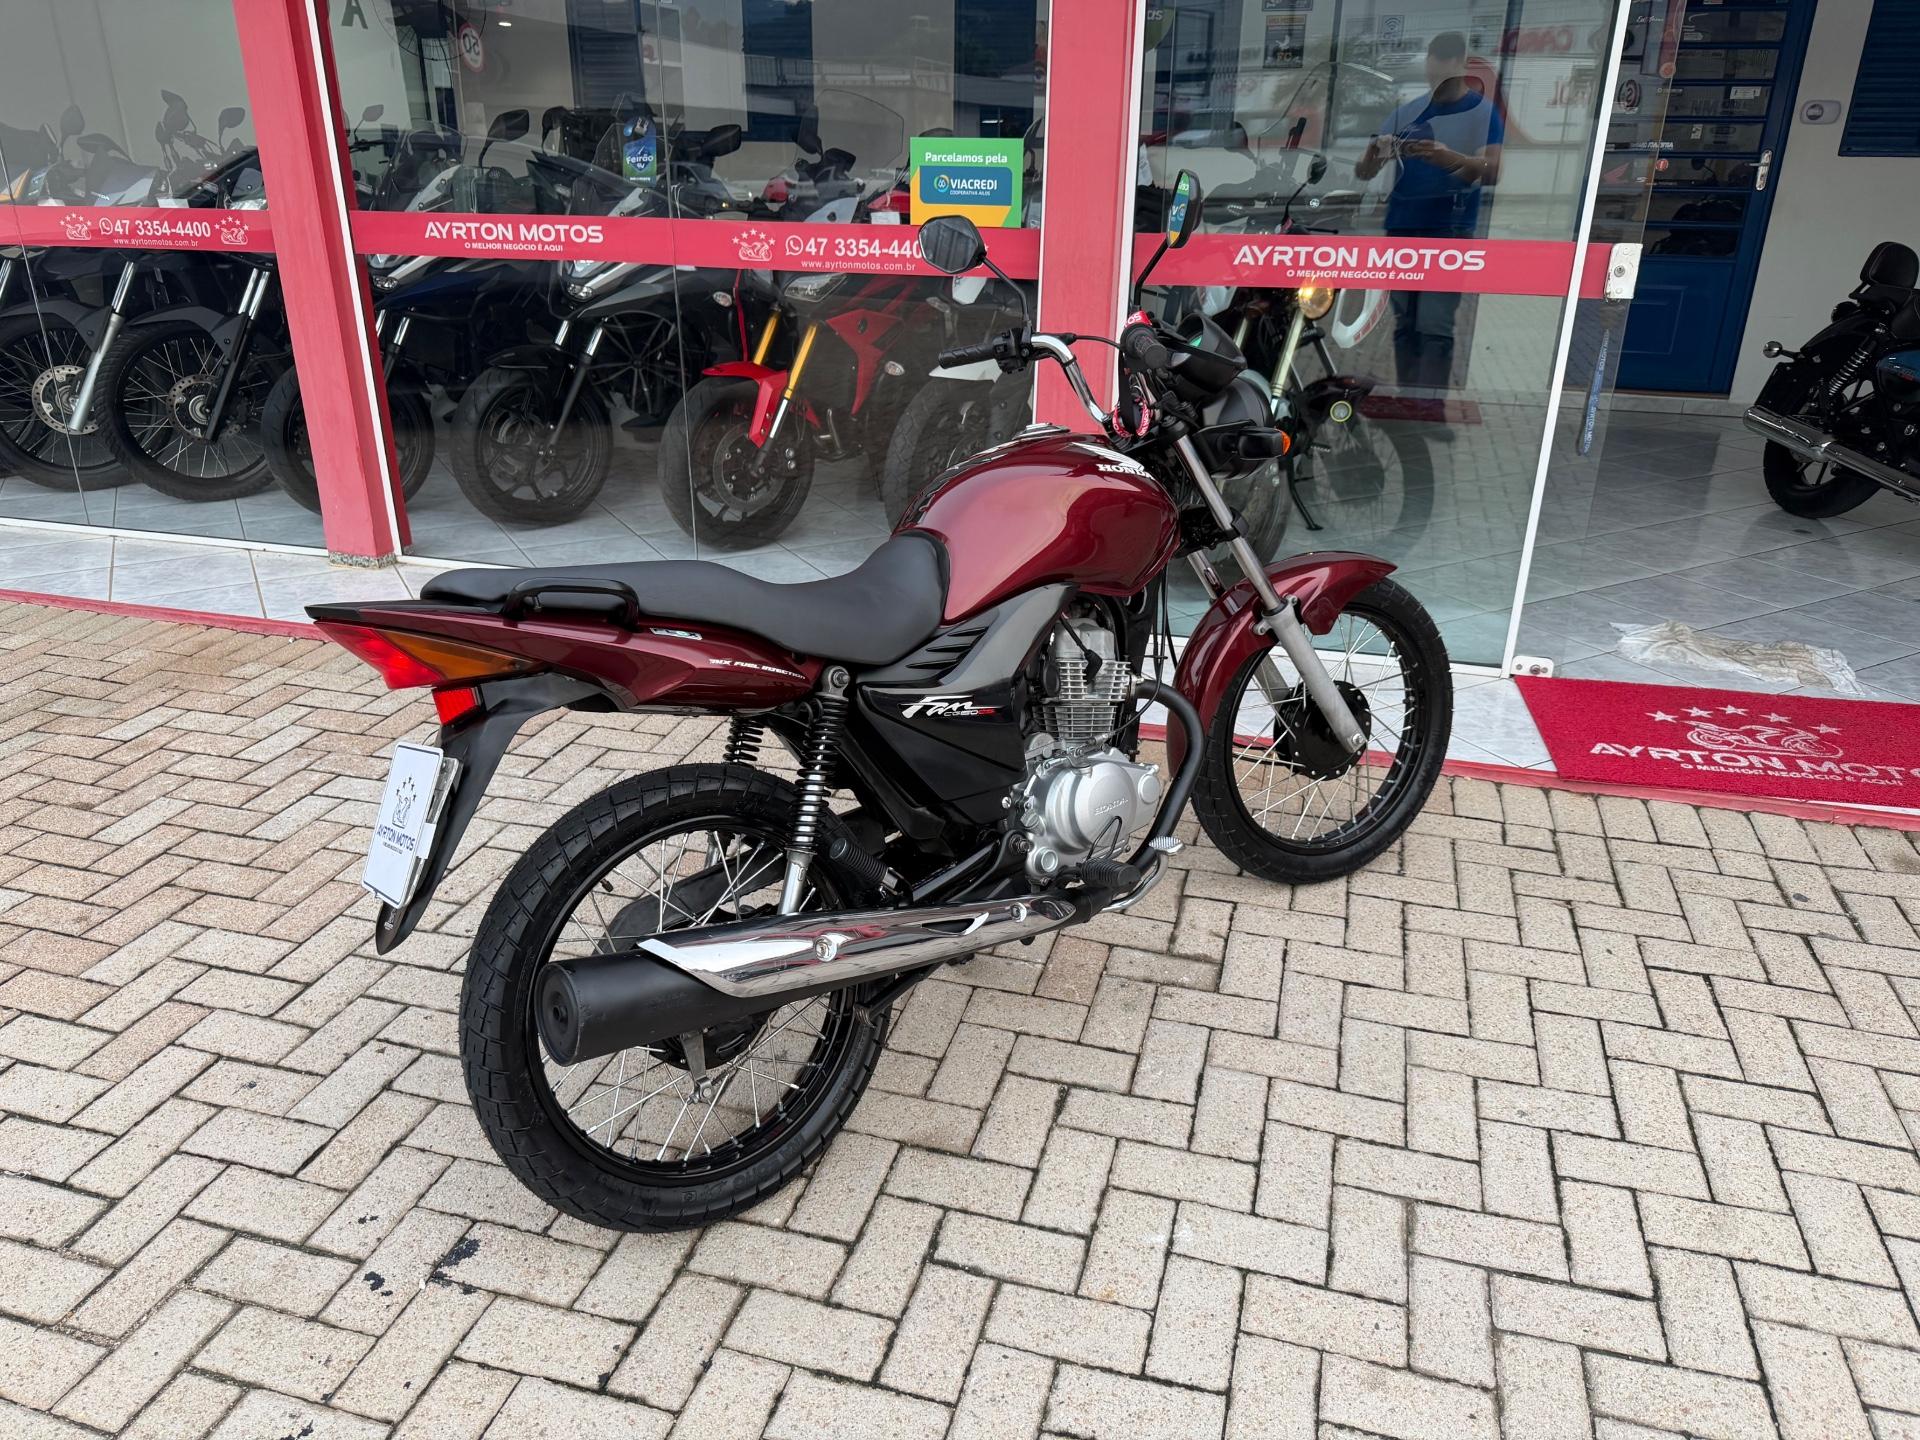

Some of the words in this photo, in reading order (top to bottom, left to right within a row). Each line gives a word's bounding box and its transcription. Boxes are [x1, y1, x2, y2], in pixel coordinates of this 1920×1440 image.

[925, 152, 983, 163] Parcelamos
[986, 153, 1008, 165] pela
[950, 179, 998, 190] VIACREDI
[114, 219, 130, 236] 47
[135, 219, 211, 238] 3354-4400
[425, 221, 514, 241] AYRTON
[520, 224, 604, 243] MOTOS
[113, 238, 199, 247] www.ayrtonmotos.com.br
[472, 242, 502, 250] MELHOR
[503, 242, 537, 251] NEGÓCIO
[537, 243, 543, 251] É
[543, 244, 563, 252] AQUI
[805, 238, 828, 257] 47
[801, 260, 916, 271] www.ayrtonmotos.com.br
[1233, 245, 1359, 268] AYRTON
[1367, 248, 1487, 271] MOTOS
[1286, 269, 1295, 277] O
[1296, 269, 1338, 278] MELHOR
[1340, 269, 1387, 279] NEGÓCIO
[1389, 270, 1396, 279] É
[1397, 272, 1425, 280] AQUI
[1590, 741, 1787, 770] AYRTON
[377, 824, 399, 843] AYRTON
[397, 831, 416, 851] MOTOS
